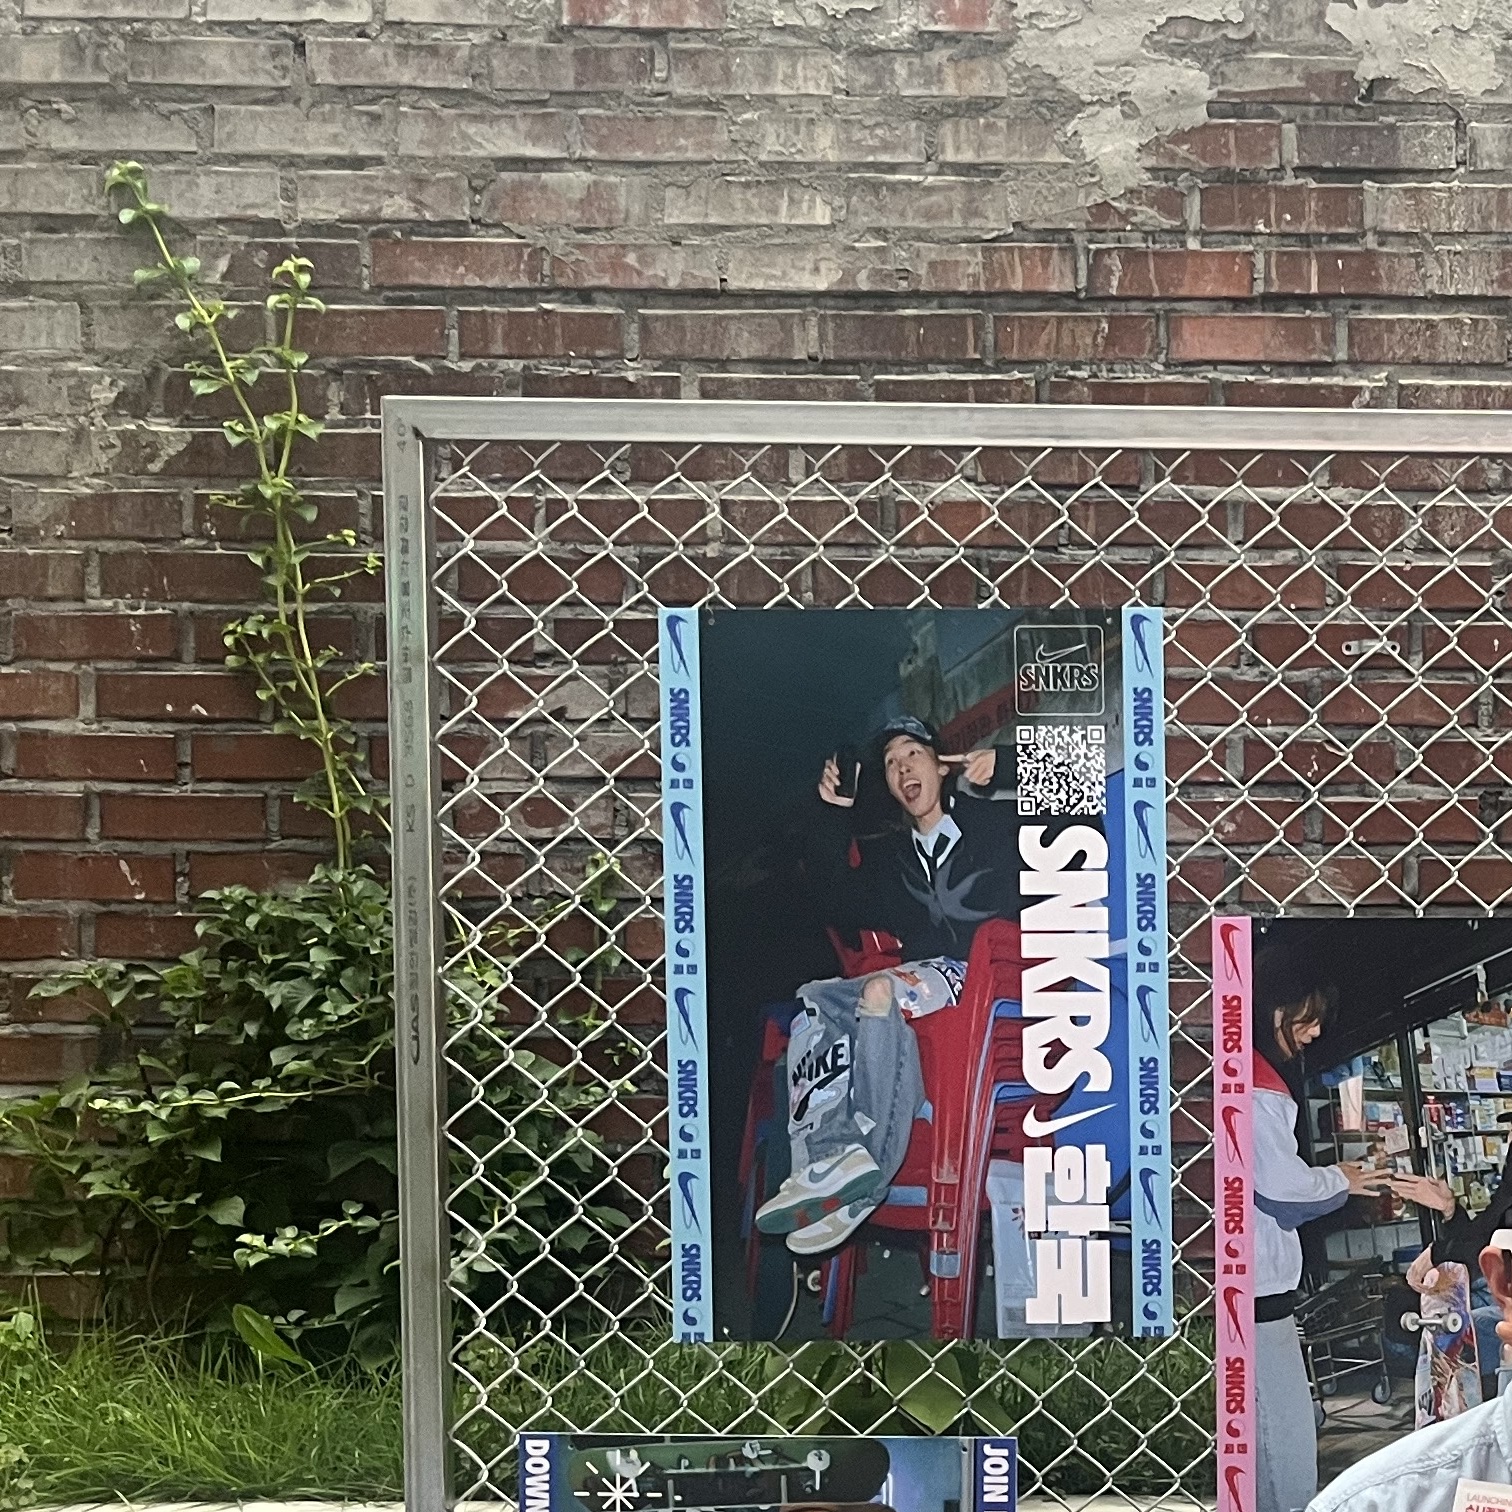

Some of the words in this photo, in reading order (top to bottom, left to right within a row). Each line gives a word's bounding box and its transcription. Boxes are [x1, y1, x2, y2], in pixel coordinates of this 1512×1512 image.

[1019, 663, 1099, 692] SNKRS
[669, 687, 692, 748] SNKRS
[1132, 687, 1154, 747] SNKRS
[672, 872, 696, 934] SNKRS
[1135, 870, 1158, 931] SNKRS
[1018, 824, 1114, 1095] SNKRS
[1221, 994, 1242, 1053] SNKRS
[676, 1058, 699, 1118] SNKRS
[791, 1042, 846, 1086] NIKE
[1138, 1056, 1161, 1115] SNKRS
[1023, 1144, 1112, 1325] 한국
[1223, 1176, 1244, 1235] SNKRS
[680, 1243, 703, 1302] SNKRS
[1140, 1238, 1163, 1297] SNKRS
[1225, 1356, 1246, 1415] SNKRS
[983, 1443, 1009, 1503] JOIN
